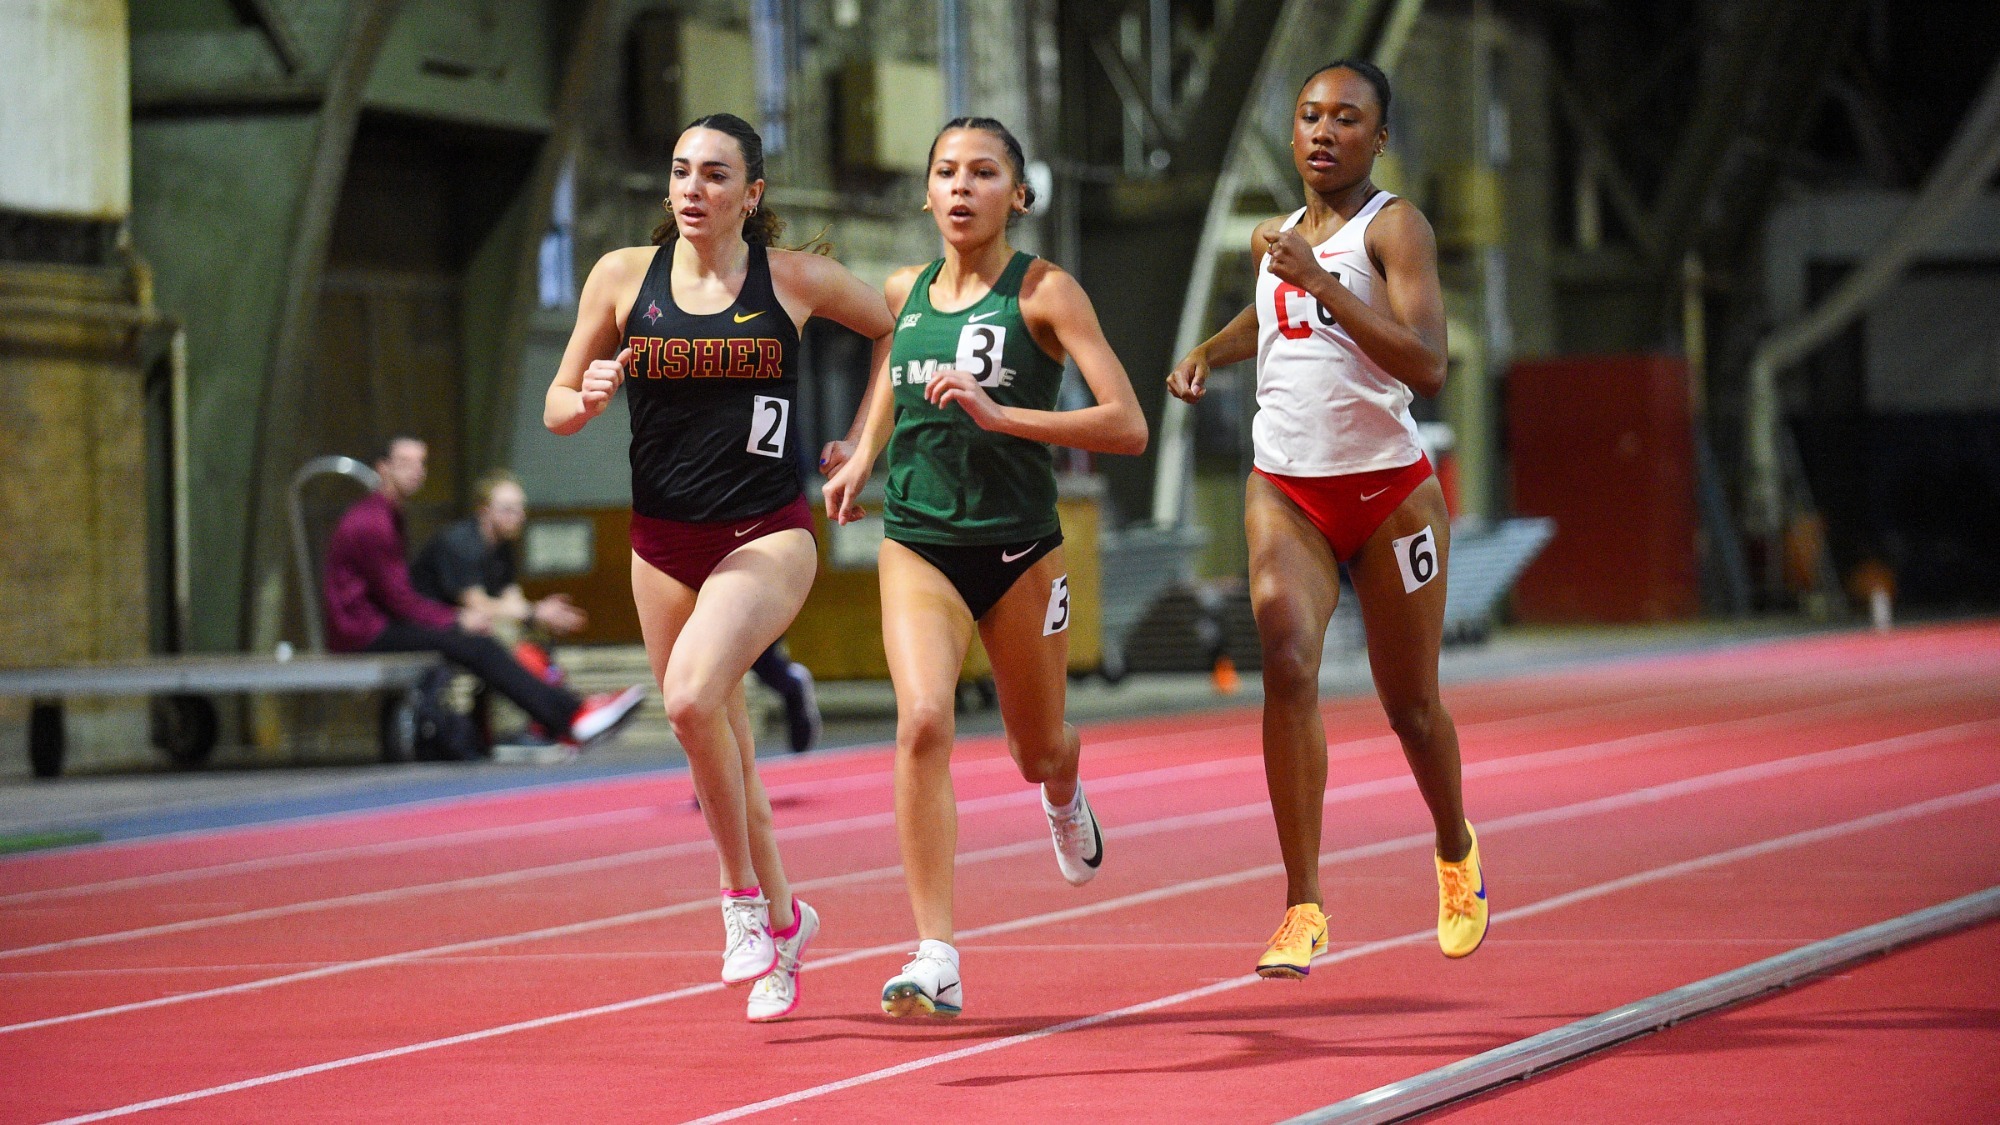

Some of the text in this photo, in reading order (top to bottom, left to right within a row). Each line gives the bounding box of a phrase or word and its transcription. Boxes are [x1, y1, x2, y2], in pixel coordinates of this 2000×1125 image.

[1274, 281, 1313, 340] C
[629, 336, 782, 379] FISHER
[972, 327, 996, 383] 3
[757, 400, 782, 453] 2
[1409, 533, 1433, 583] 6
[1051, 576, 1069, 630] 3
